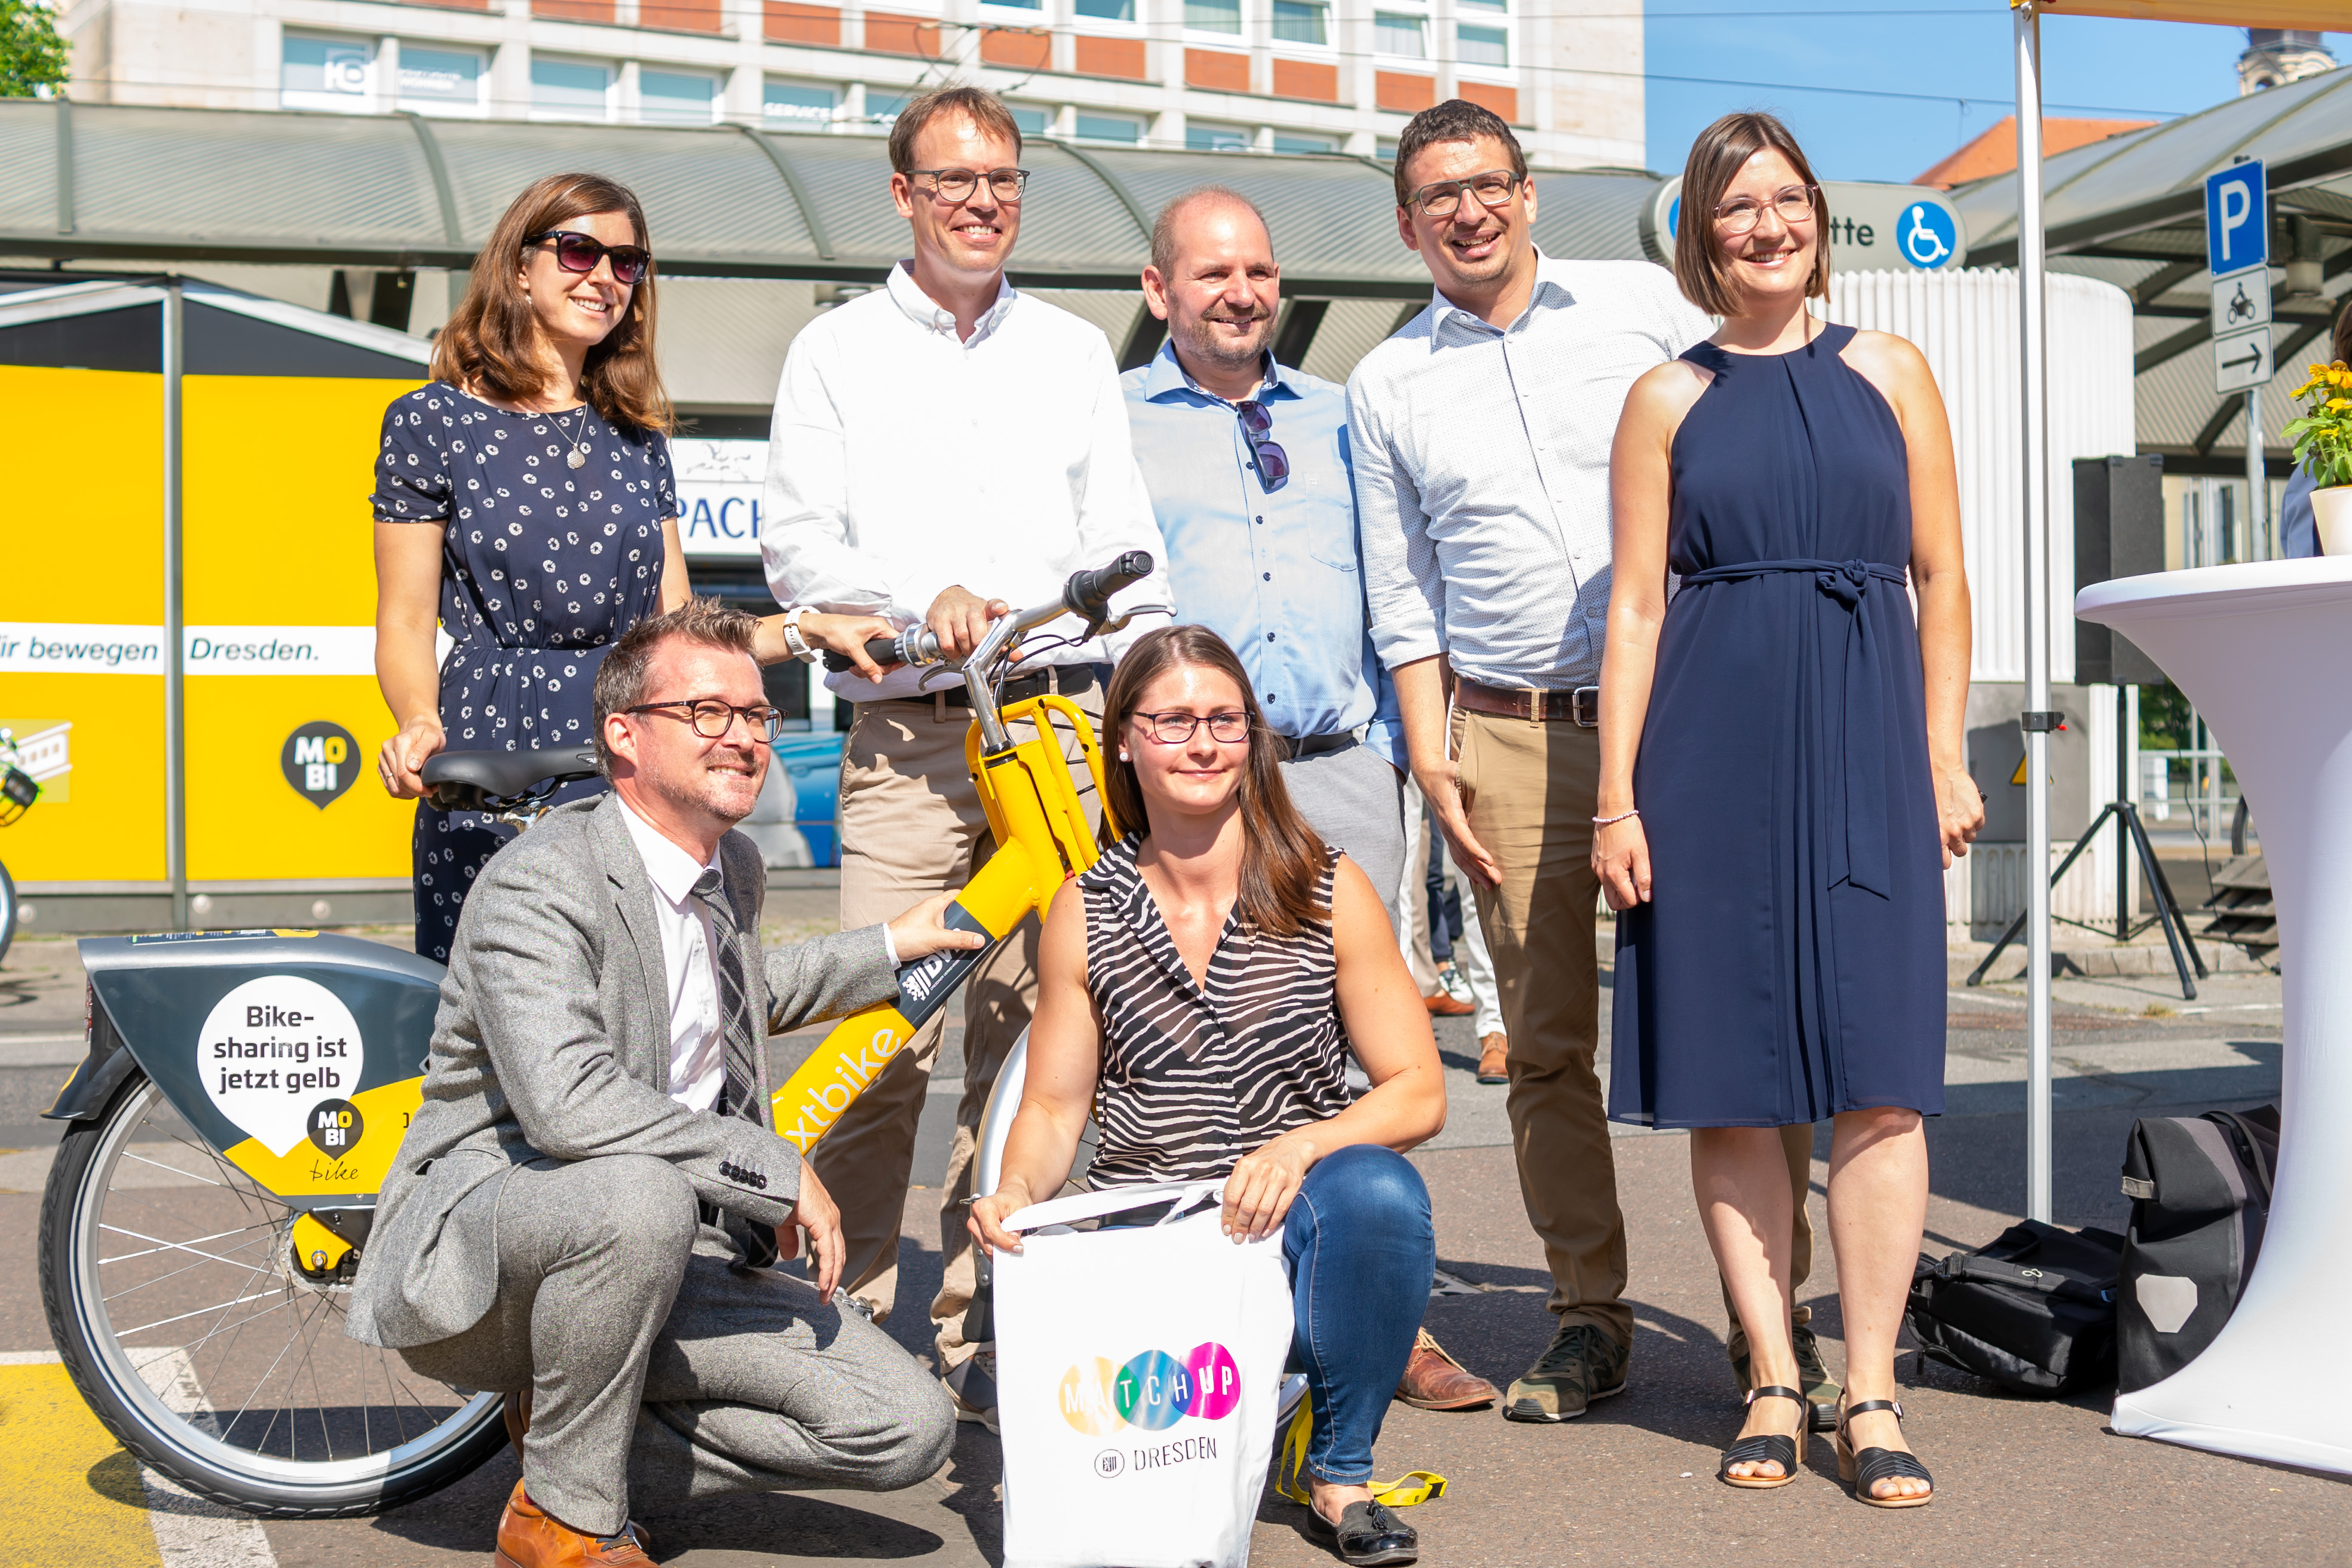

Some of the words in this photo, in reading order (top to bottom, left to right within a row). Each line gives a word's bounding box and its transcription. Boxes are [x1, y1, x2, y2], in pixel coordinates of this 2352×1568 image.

[763, 102, 832, 120] SERVICE
[1829, 216, 1875, 247] tte
[2219, 179, 2251, 261] P
[0, 634, 20, 658] ir
[27, 636, 158, 666] bewegen
[189, 637, 320, 661] Dresden.
[922, 927, 961, 979] DV
[246, 1004, 315, 1027] Bike-
[213, 1036, 310, 1063] sharing
[317, 1035, 348, 1058] ist
[218, 1067, 280, 1095] jetzt
[286, 1067, 341, 1094] gelb
[785, 1028, 901, 1152] xtbike
[310, 1159, 359, 1182] bike
[1134, 1436, 1217, 1471] DRESDEN
